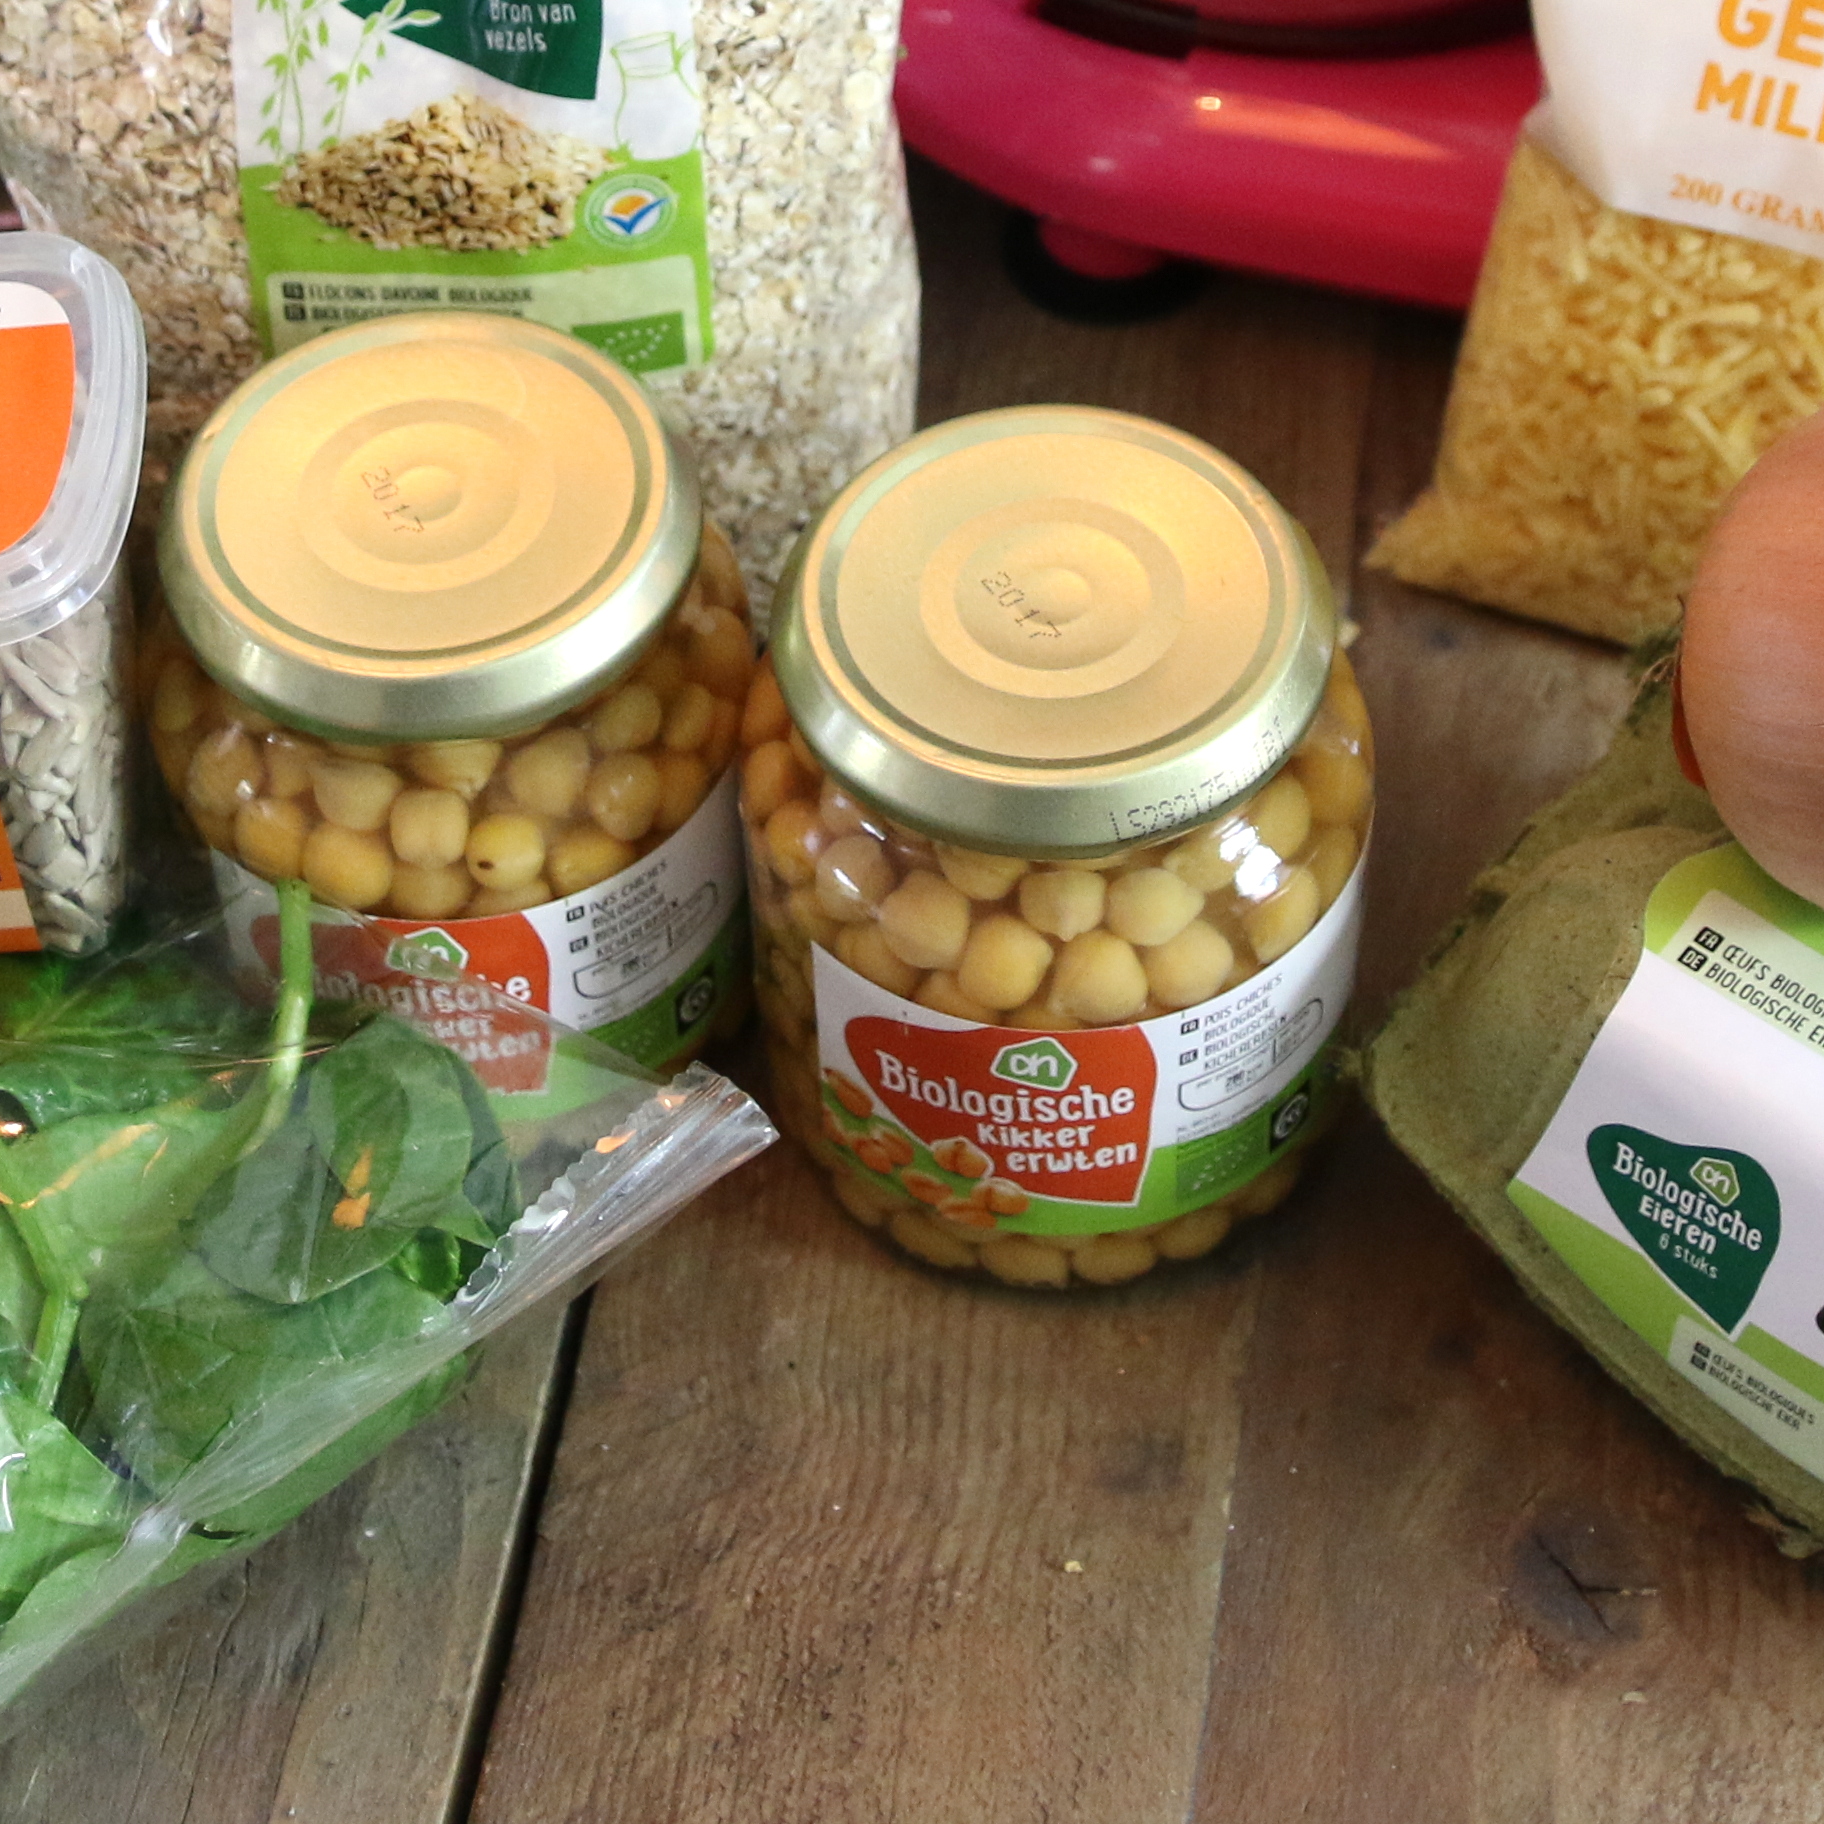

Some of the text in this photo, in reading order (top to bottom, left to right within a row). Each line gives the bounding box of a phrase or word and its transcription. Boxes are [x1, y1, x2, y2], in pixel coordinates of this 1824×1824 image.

[538, 3, 576, 23] van
[485, 28, 548, 52] vezels
[1668, 172, 1724, 207] 200
[360, 465, 425, 533] 2017
[980, 571, 1063, 638] 2017
[1696, 929, 1722, 950] FR
[1204, 1007, 1232, 1027] POIS
[1236, 973, 1284, 1011] CHICHES
[1682, 948, 1707, 970] DE
[1704, 961, 1810, 1034] BIOLOGISCHE
[1204, 996, 1270, 1043] BIOLOGIQUE
[1205, 1007, 1276, 1057] BIOLOGISCHE
[875, 1047, 1137, 1124] Biologische
[975, 1121, 1097, 1149] Kikker
[1005, 1142, 1139, 1174] erwten
[1612, 1141, 1764, 1252] Biologische
[1638, 1194, 1718, 1255] Eieren
[1659, 1232, 1719, 1279] 6 stuks
